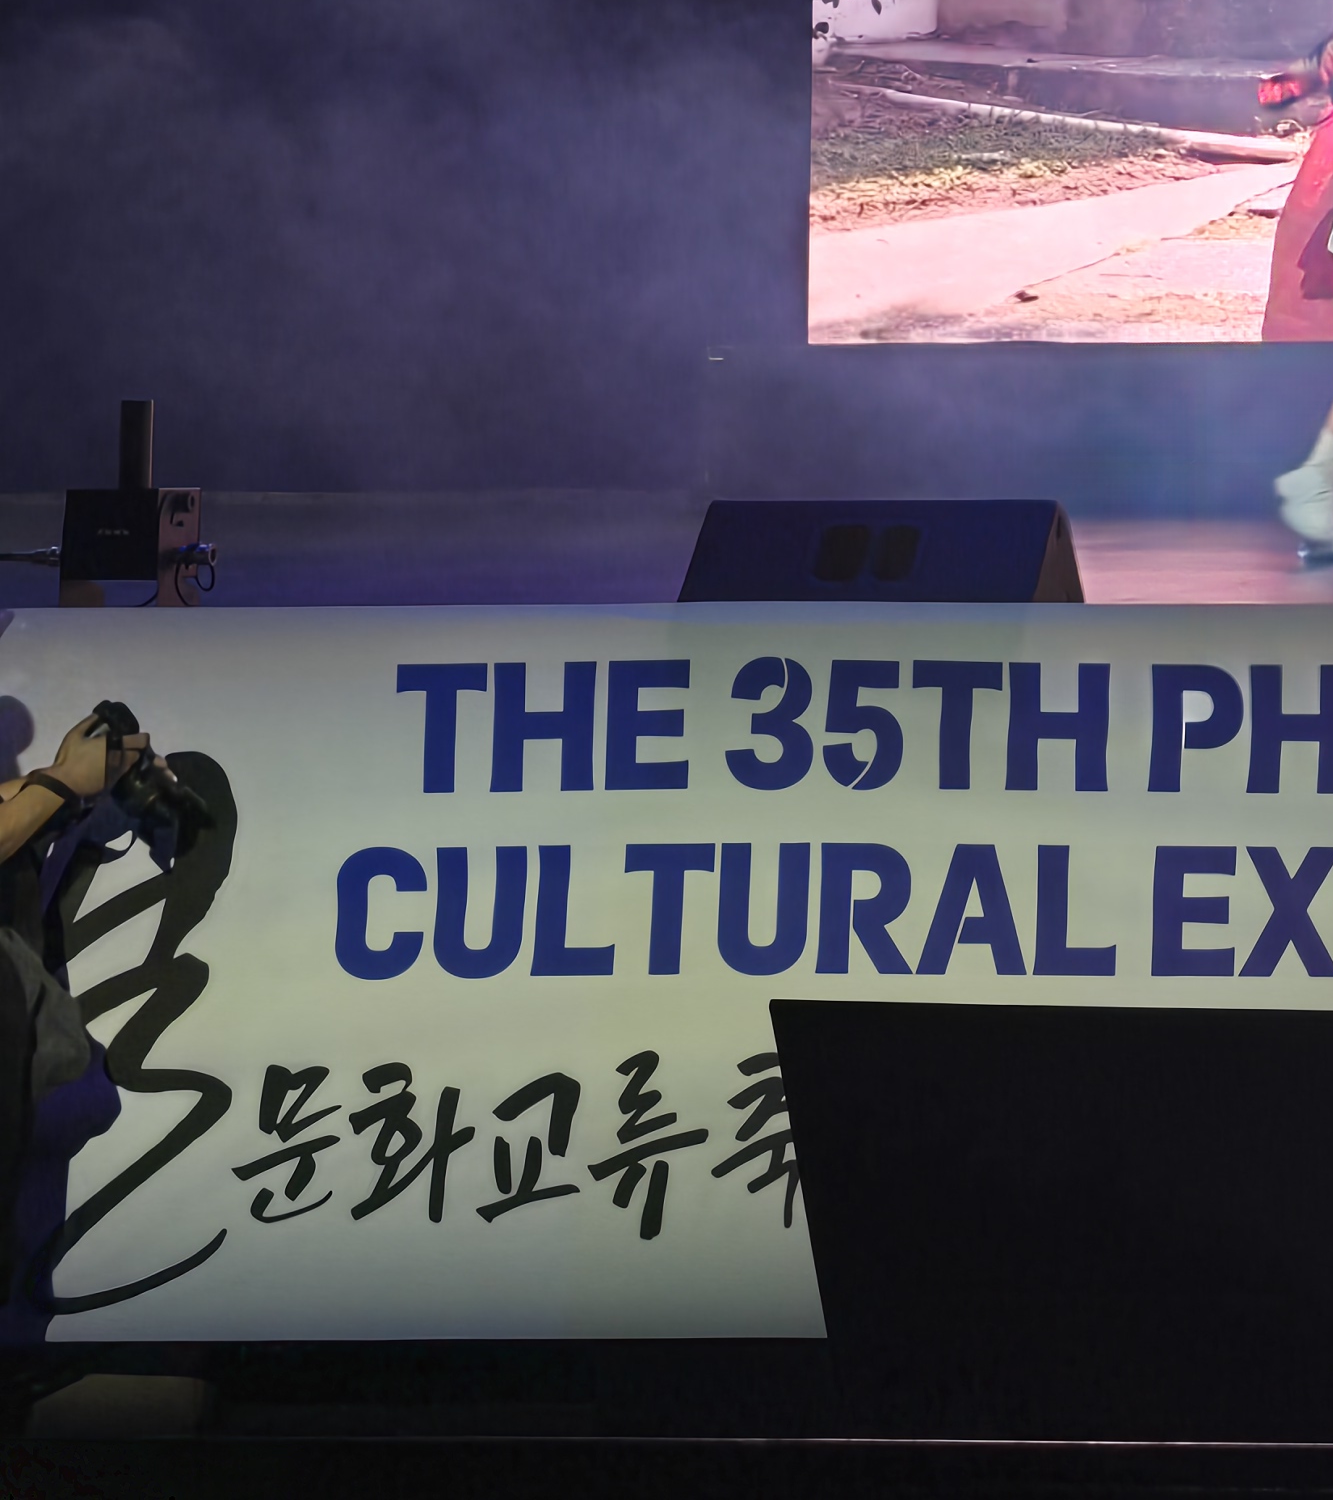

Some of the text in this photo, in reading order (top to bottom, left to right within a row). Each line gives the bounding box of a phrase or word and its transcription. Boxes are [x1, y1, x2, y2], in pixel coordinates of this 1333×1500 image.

[396, 659, 691, 793] THE
[724, 656, 1111, 792] 35TH
[334, 842, 1117, 980] CULTURAL
